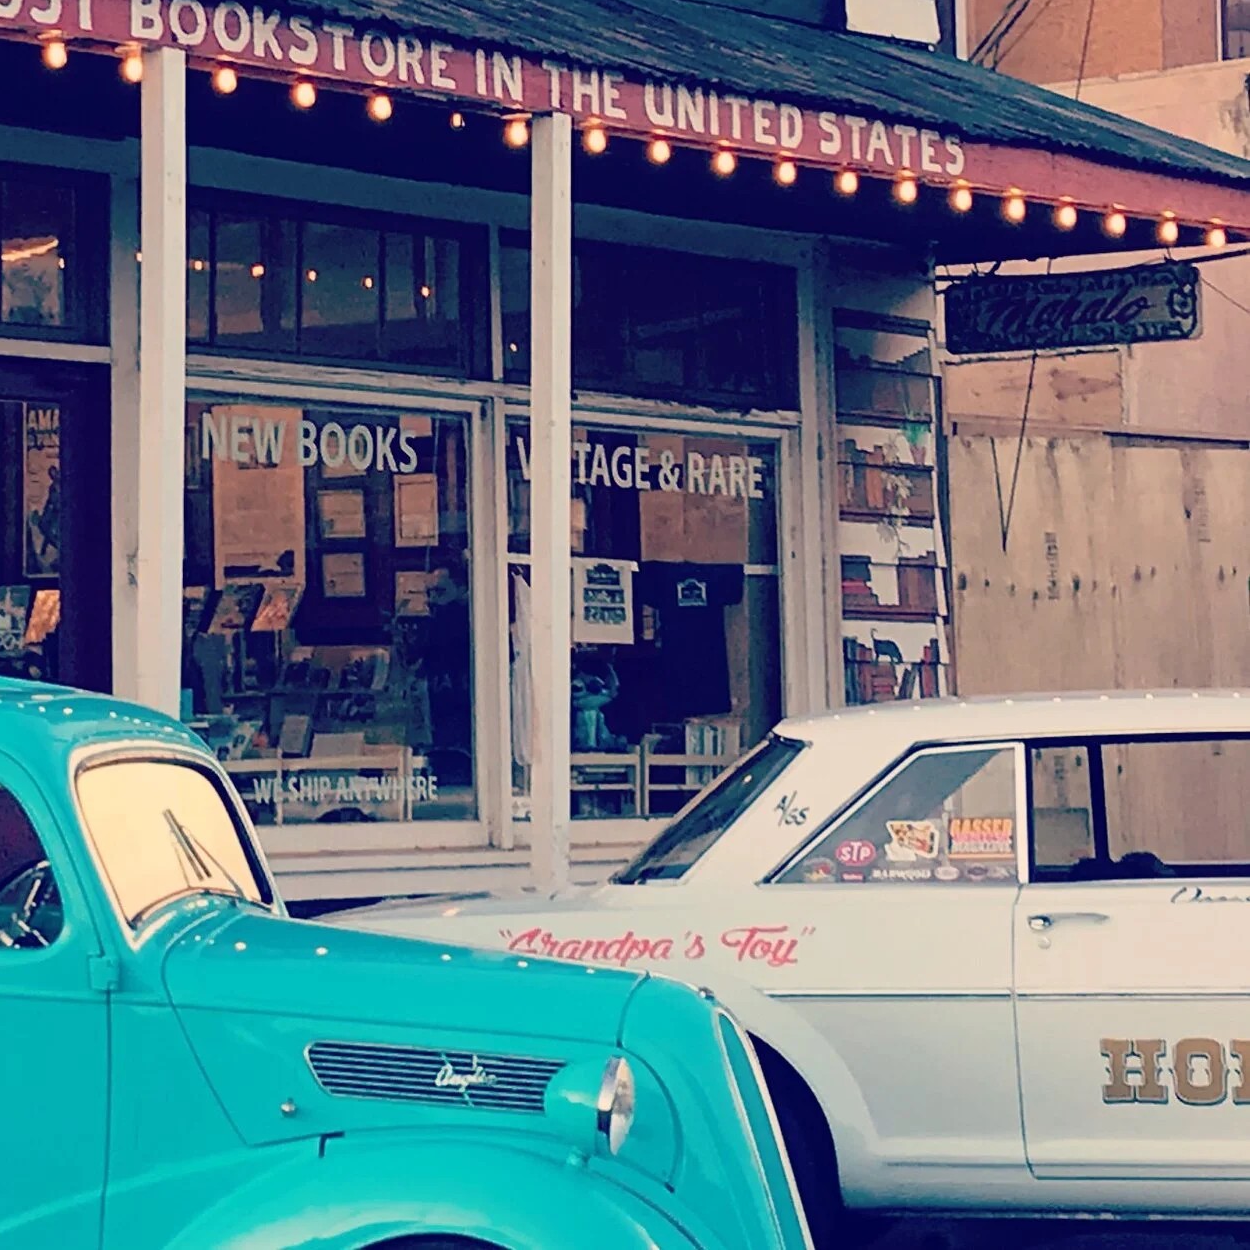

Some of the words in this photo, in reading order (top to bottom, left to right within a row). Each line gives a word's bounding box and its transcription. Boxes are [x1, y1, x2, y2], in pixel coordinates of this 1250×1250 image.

[476, 48, 524, 102] IN
[548, 59, 626, 119] THE
[643, 79, 804, 148] UNITED
[819, 111, 965, 176] STATES
[202, 412, 287, 464] NEW
[298, 420, 419, 474] BOOKS
[516, 436, 651, 490] VTAGE
[658, 450, 681, 494] &
[688, 452, 764, 499] RARE
[287, 775, 332, 802] SHIP
[335, 775, 439, 802] ANYWHERE
[839, 840, 872, 863] STP
